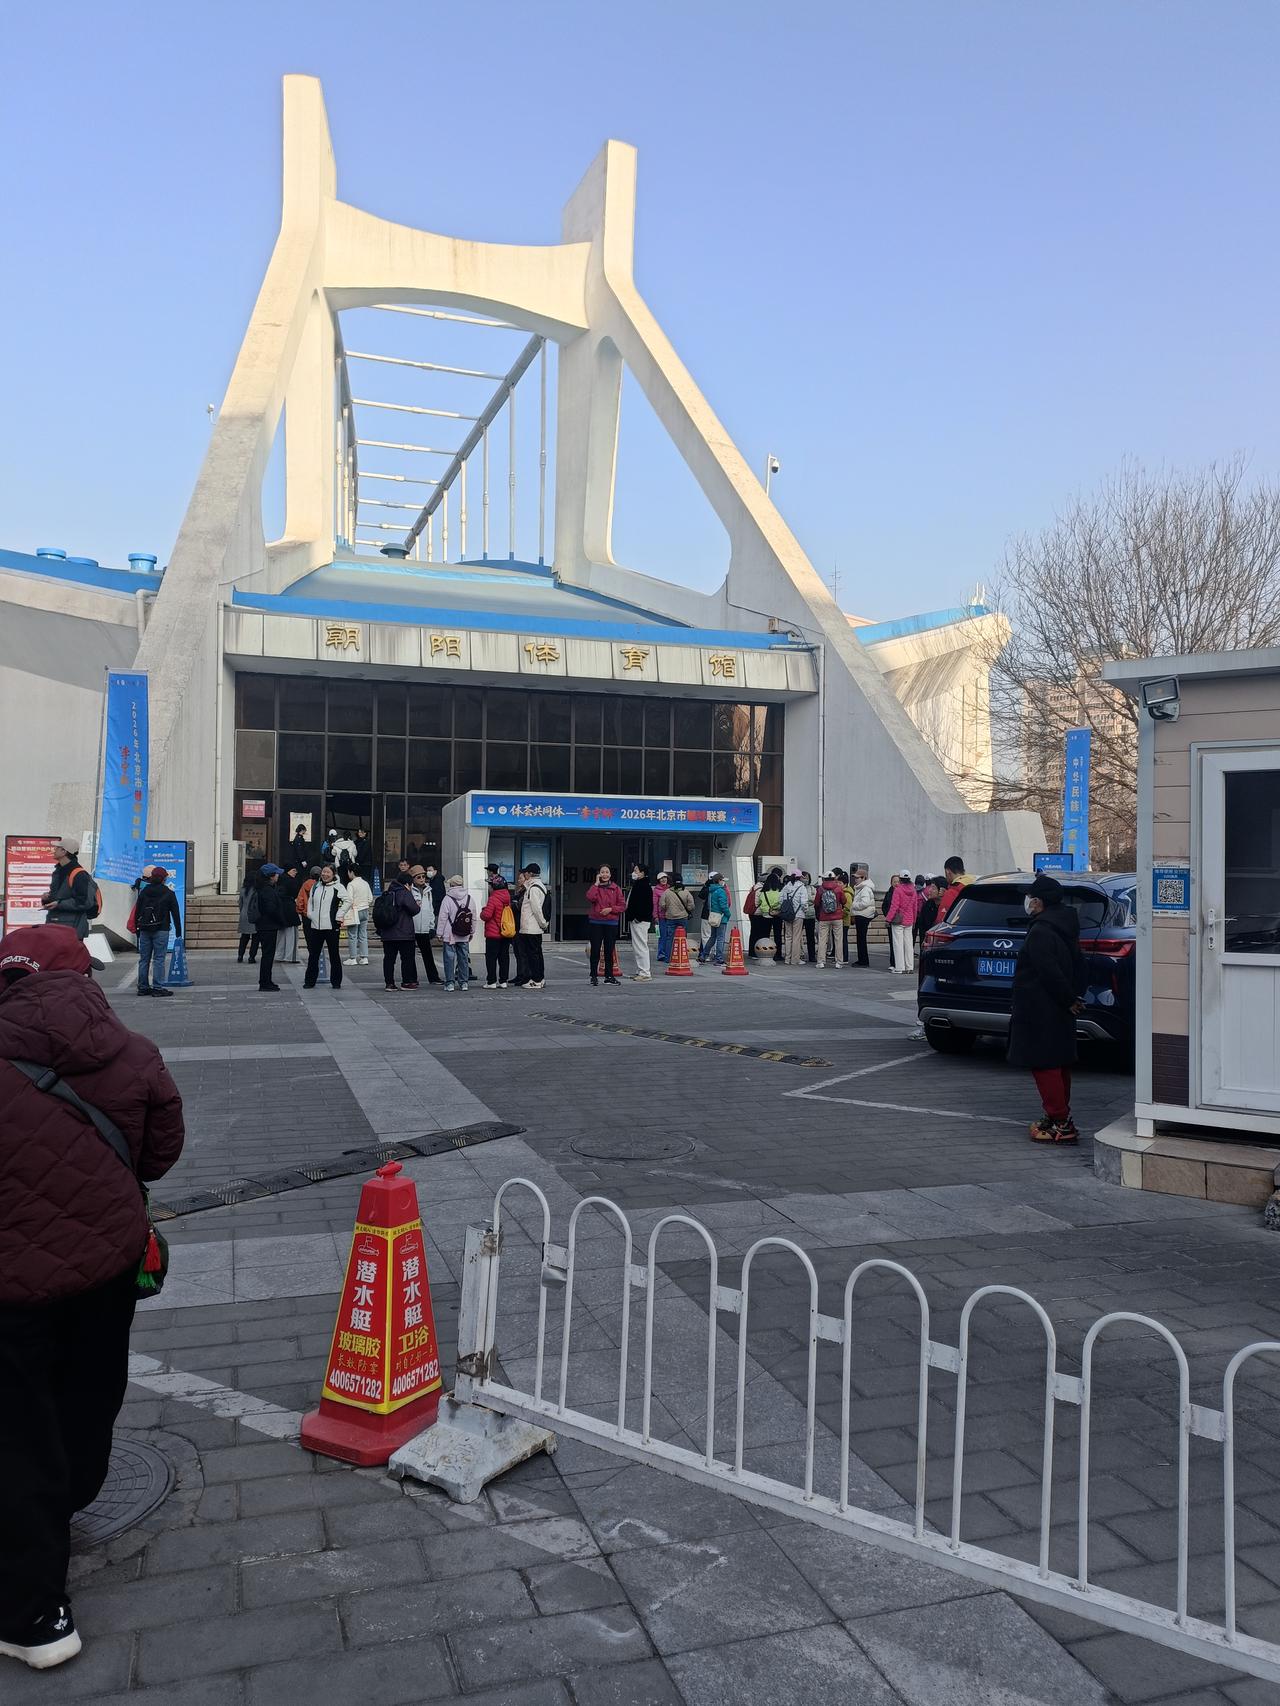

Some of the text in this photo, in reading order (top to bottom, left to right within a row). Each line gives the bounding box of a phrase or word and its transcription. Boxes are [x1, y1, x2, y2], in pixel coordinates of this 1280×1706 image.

[326, 624, 737, 679] 朝阳体育馆
[350, 1259, 377, 1332] 潜水艇
[402, 1256, 423, 1330] 潜水艇
[337, 1330, 381, 1359] 玻璃胶
[398, 1325, 429, 1355] 卫浴
[329, 1368, 382, 1400] 4006571282
[392, 1359, 439, 1397] 4006571282
